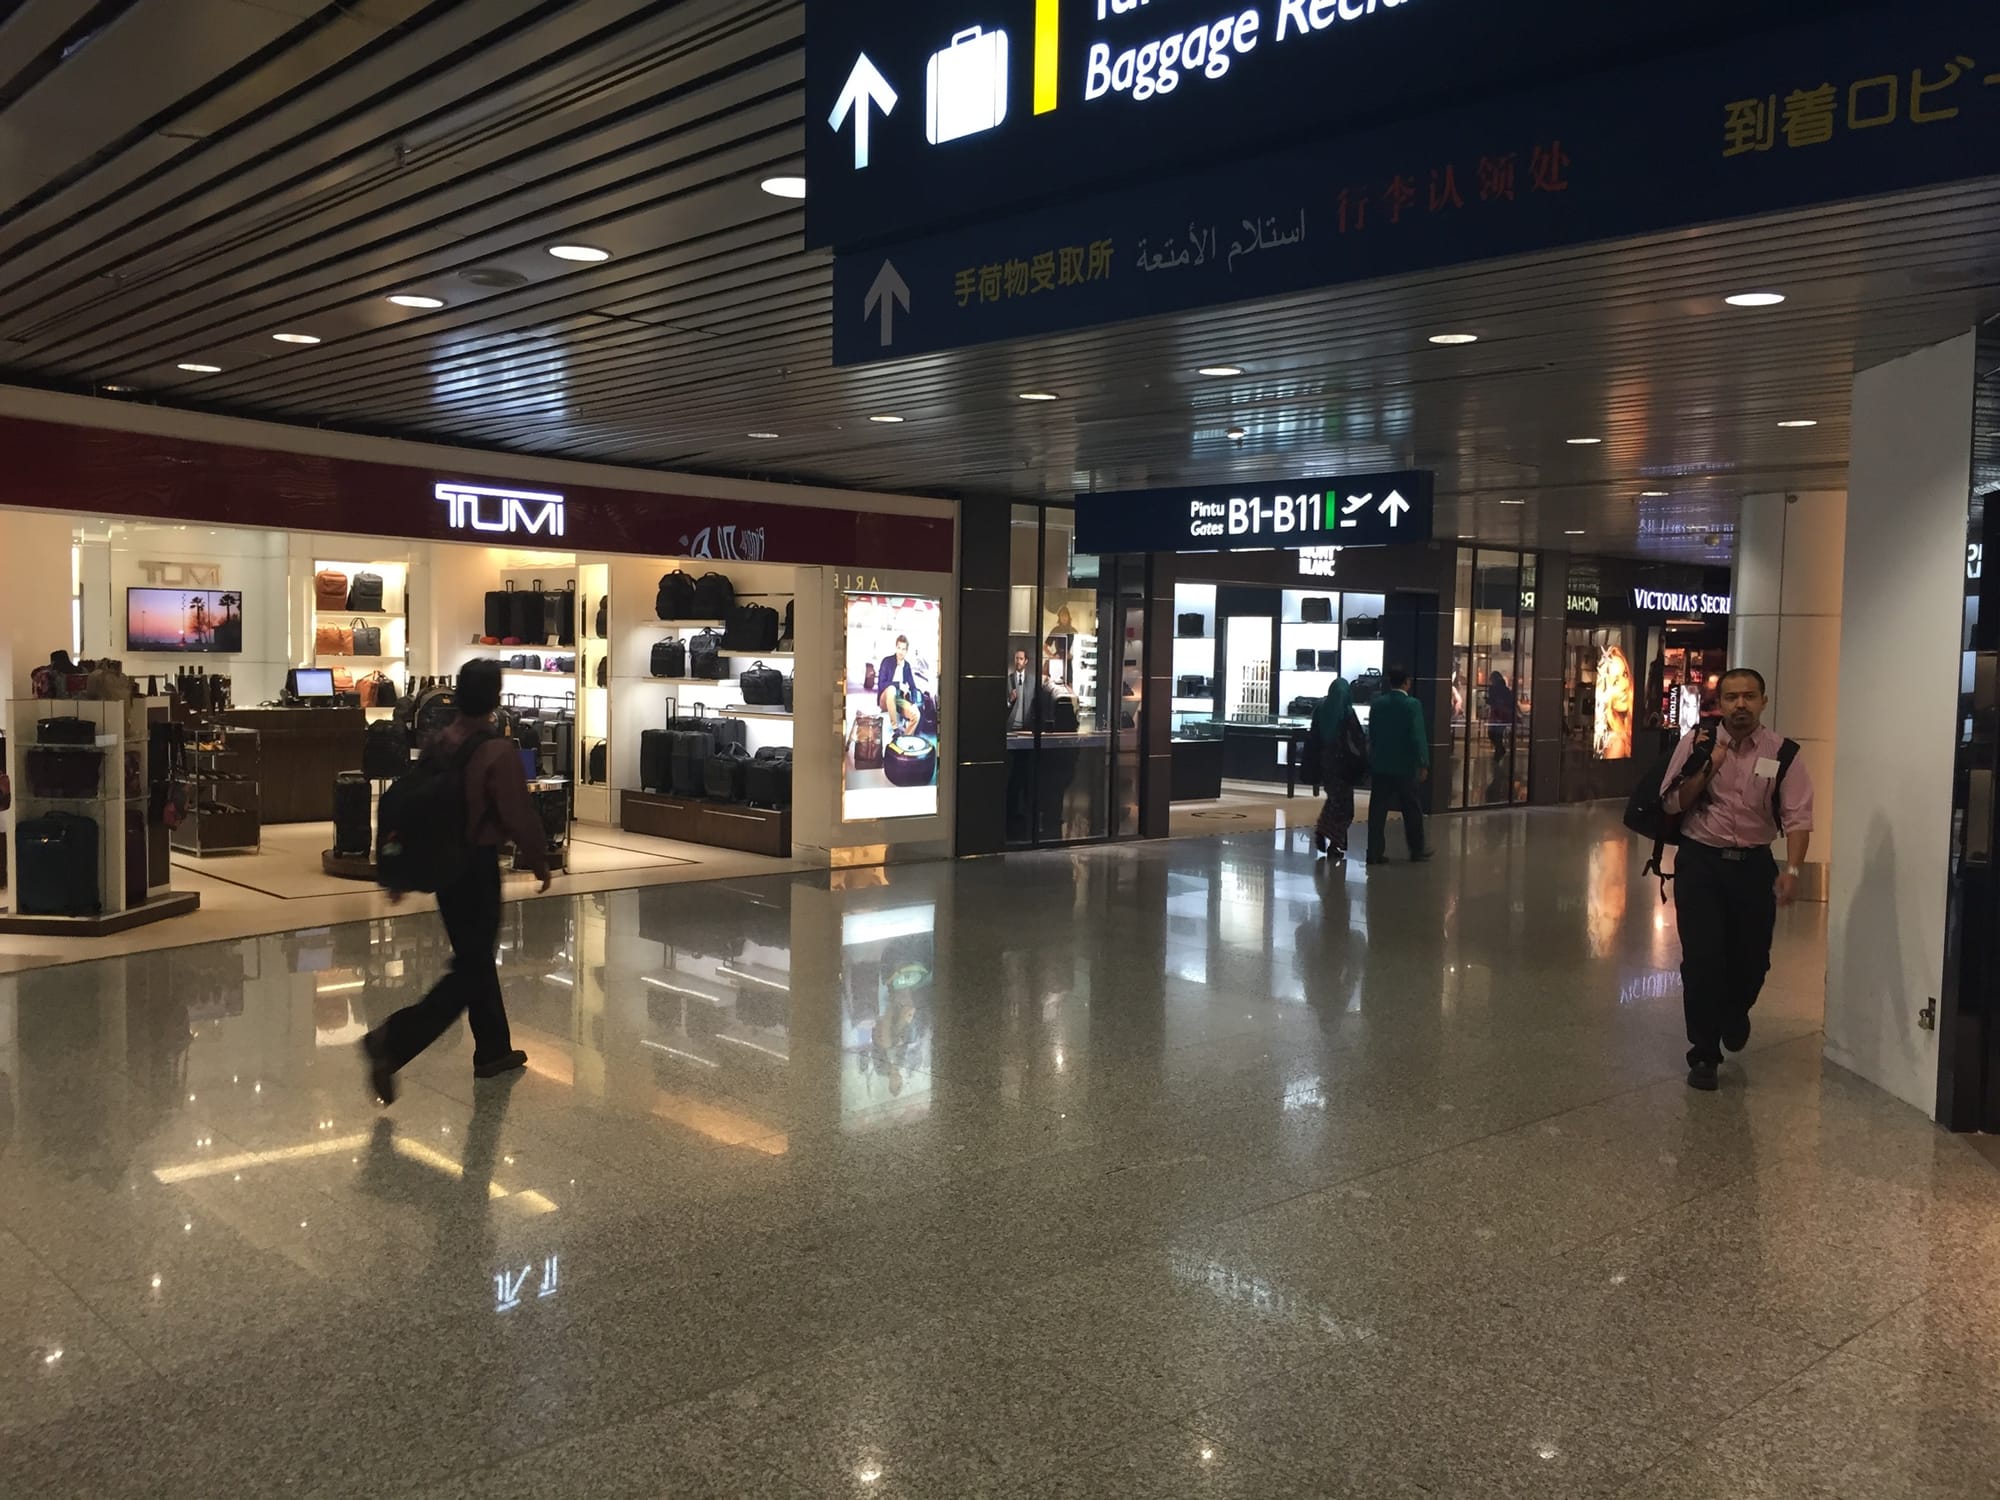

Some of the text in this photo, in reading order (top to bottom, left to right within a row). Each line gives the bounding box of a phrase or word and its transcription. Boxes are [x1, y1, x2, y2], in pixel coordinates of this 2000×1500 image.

[1084, 10, 1260, 101] Baggage
[1337, 140, 1571, 234] 行李认领处
[954, 238, 1116, 308] 手荷物受取所
[434, 482, 565, 537] TUMI
[1190, 500, 1225, 518] Pintu
[1190, 519, 1224, 537] Gates
[1228, 493, 1321, 535] B1-B11
[138, 560, 221, 586] TUMI
